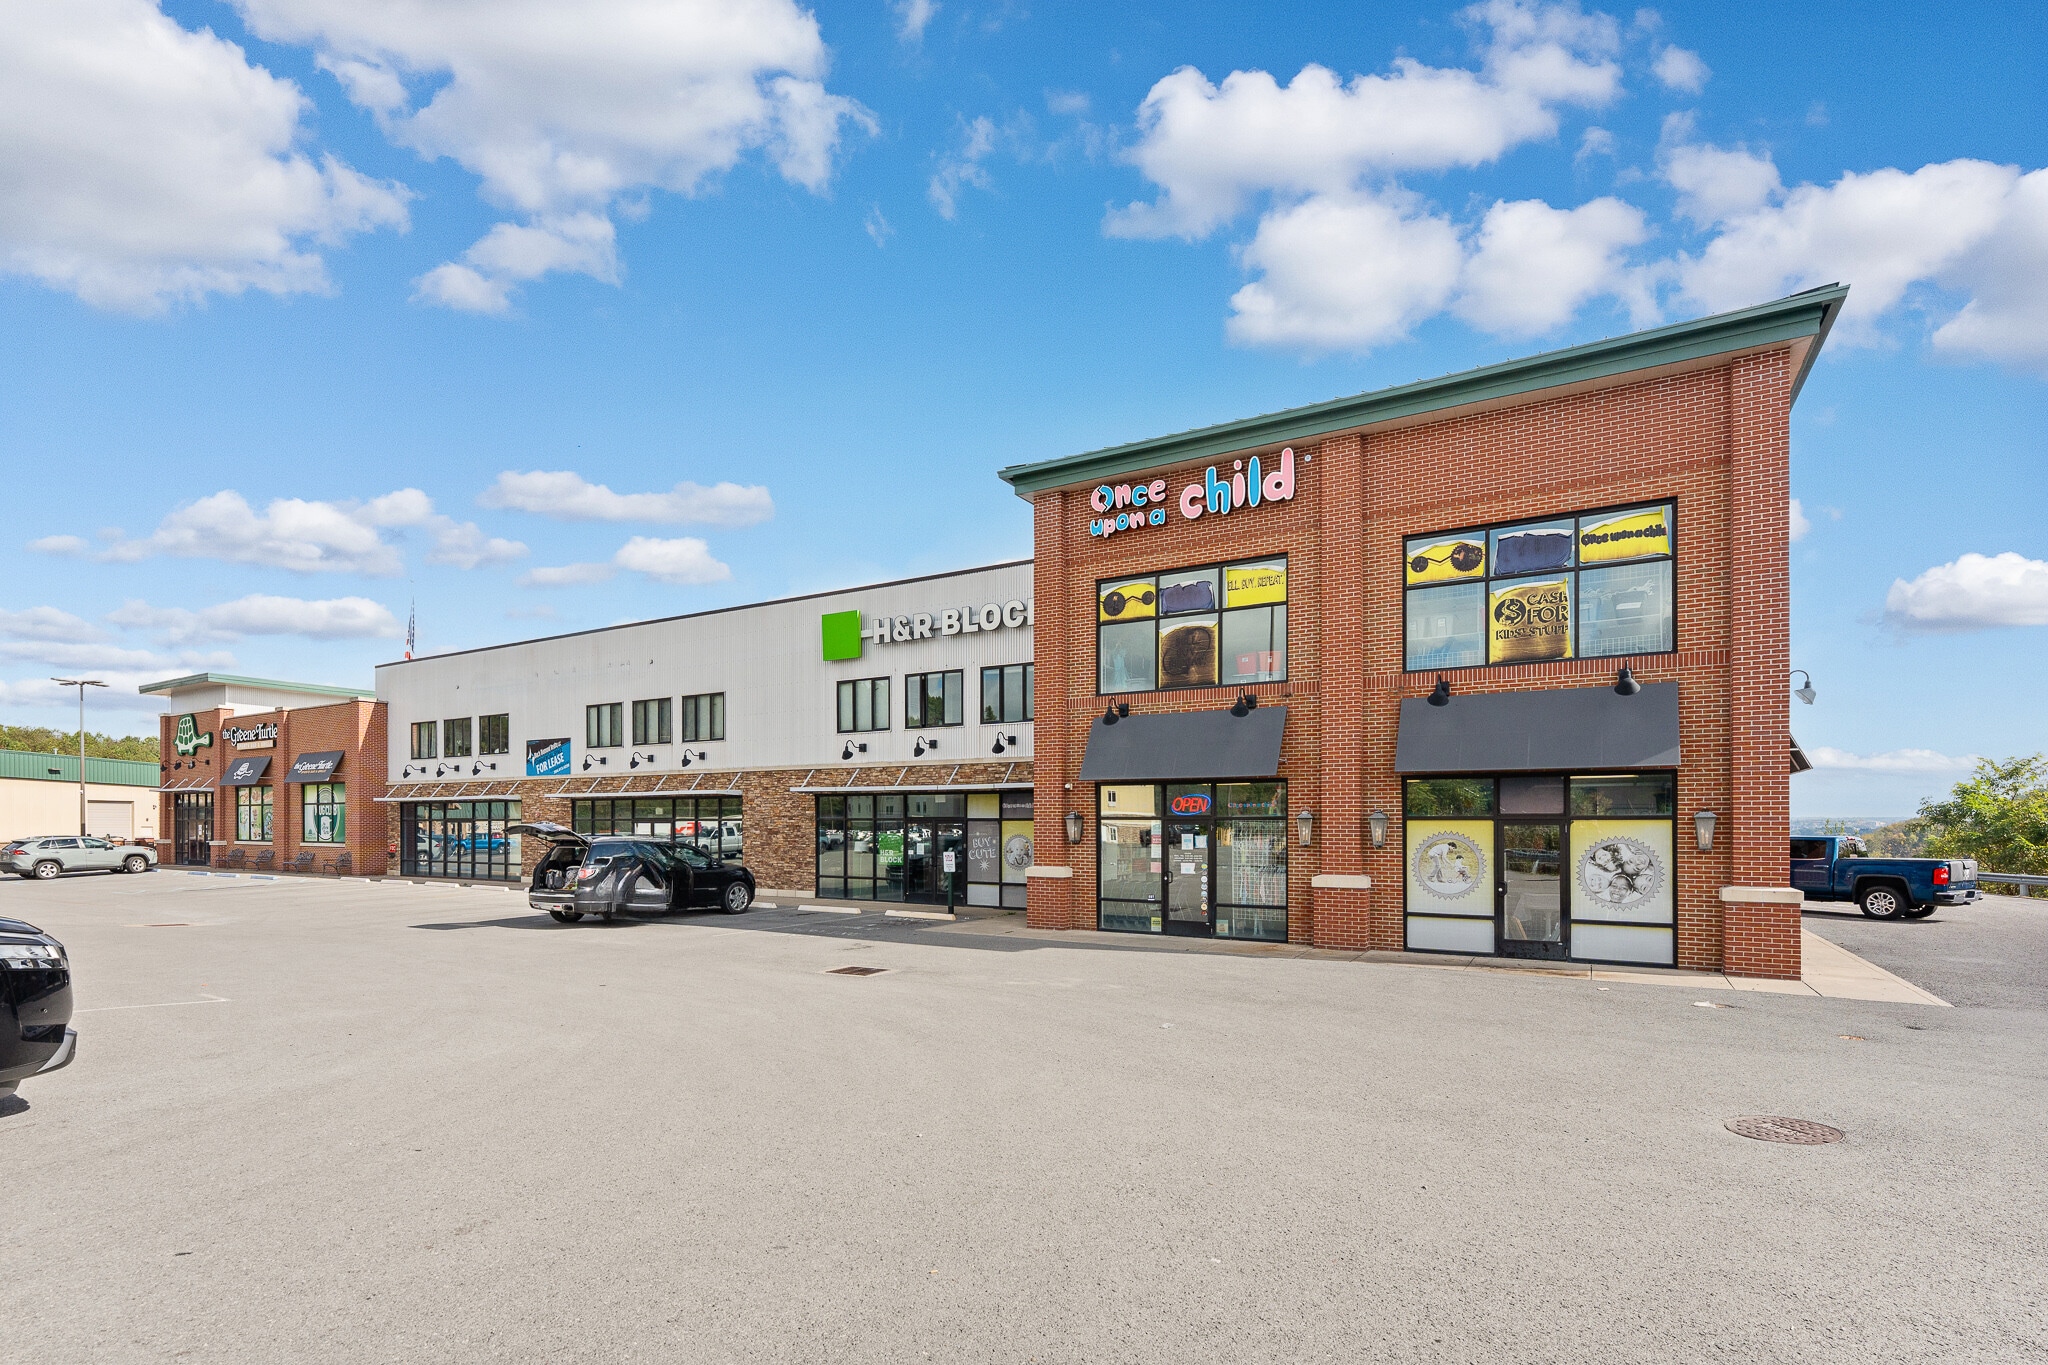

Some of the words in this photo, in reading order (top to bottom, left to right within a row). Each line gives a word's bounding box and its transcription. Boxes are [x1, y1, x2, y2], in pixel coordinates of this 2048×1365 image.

[1179, 447, 1296, 519] child
[1091, 480, 1166, 513] Once
[1090, 511, 1145, 538] upon
[1149, 508, 1166, 525] a
[873, 614, 937, 645] H&R
[942, 598, 1034, 636] BLOC
[1526, 604, 1569, 625] FOR
[222, 729, 231, 739] the
[231, 727, 256, 747] Greene
[256, 723, 278, 740] Turtle
[536, 762, 548, 774] FOR
[548, 753, 564, 769] LEASE
[1172, 797, 1208, 812] OPEN
[972, 836, 992, 848] BUY
[880, 856, 903, 864] BLOCK
[969, 849, 997, 860] CUTE
